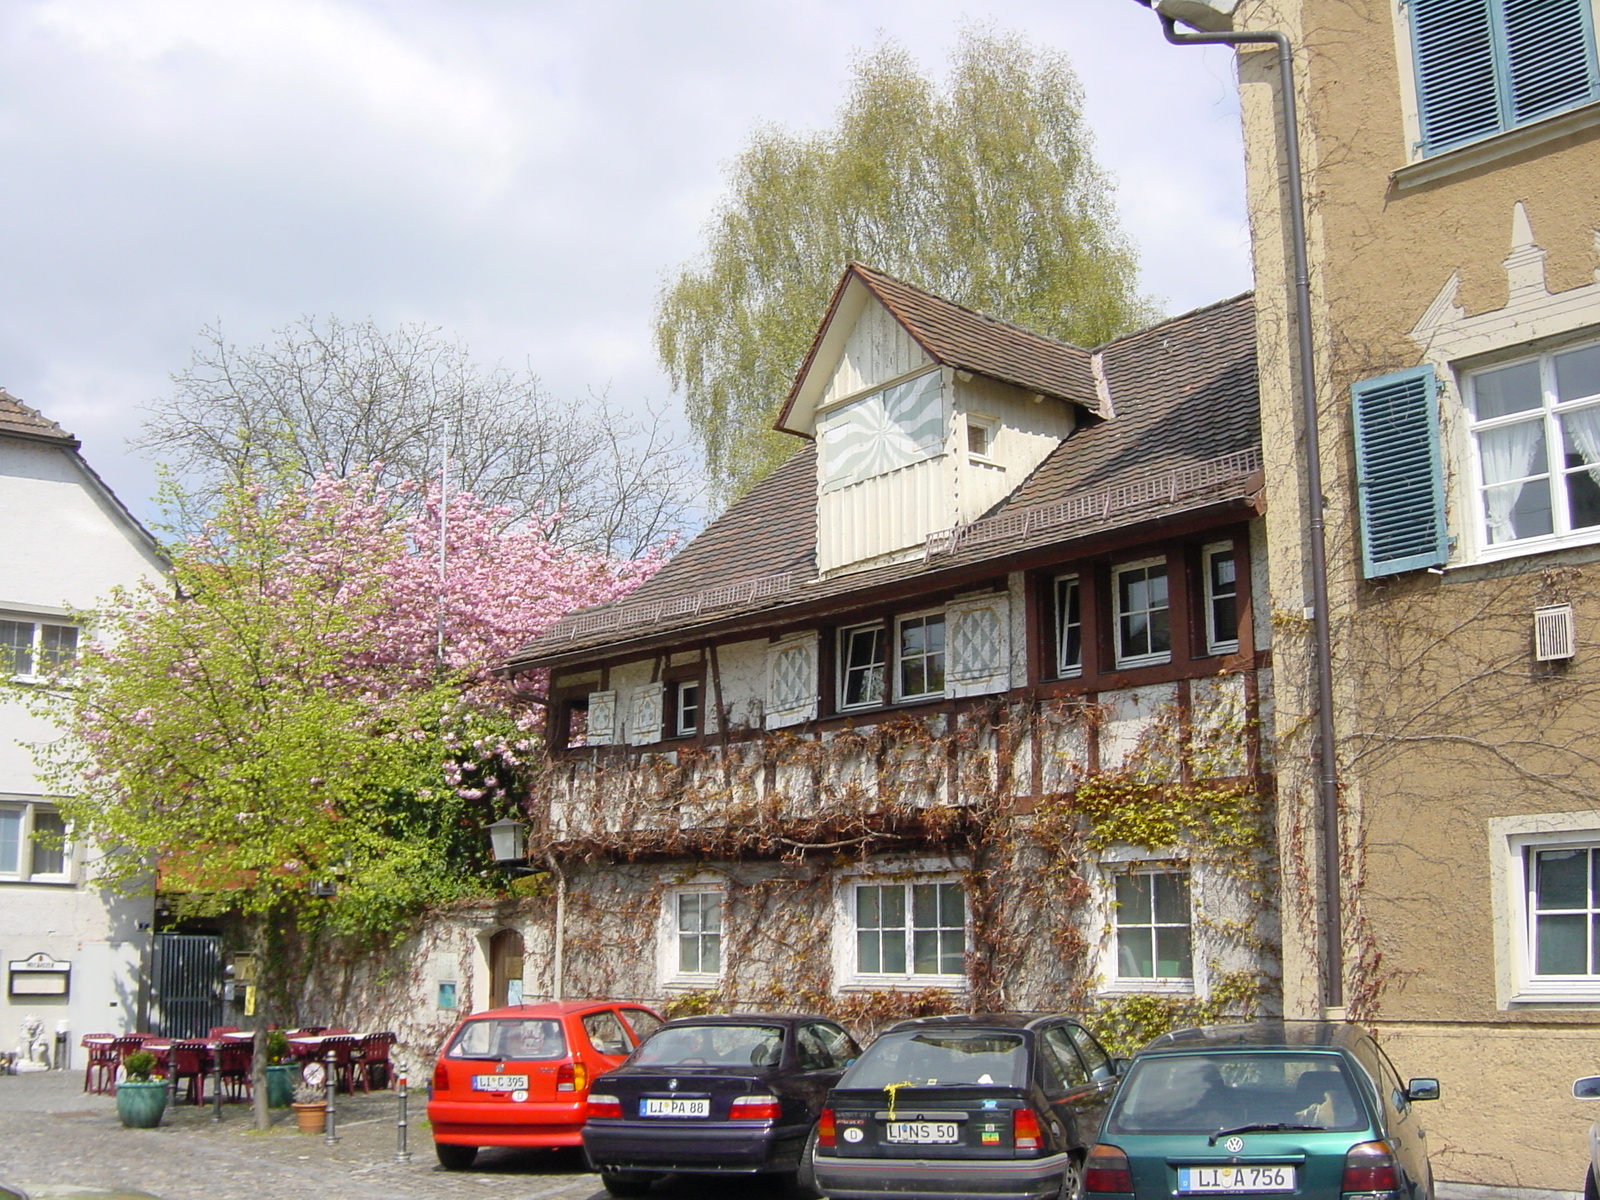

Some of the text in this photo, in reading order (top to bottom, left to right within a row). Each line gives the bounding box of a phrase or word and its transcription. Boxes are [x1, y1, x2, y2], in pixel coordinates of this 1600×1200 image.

[480, 1077, 524, 1087] LI C 395
[650, 1102, 704, 1113] LI PA 88
[850, 1130, 857, 1140] D
[889, 1124, 955, 1138] LI NS 50
[1199, 1168, 1285, 1187] LI A 756
